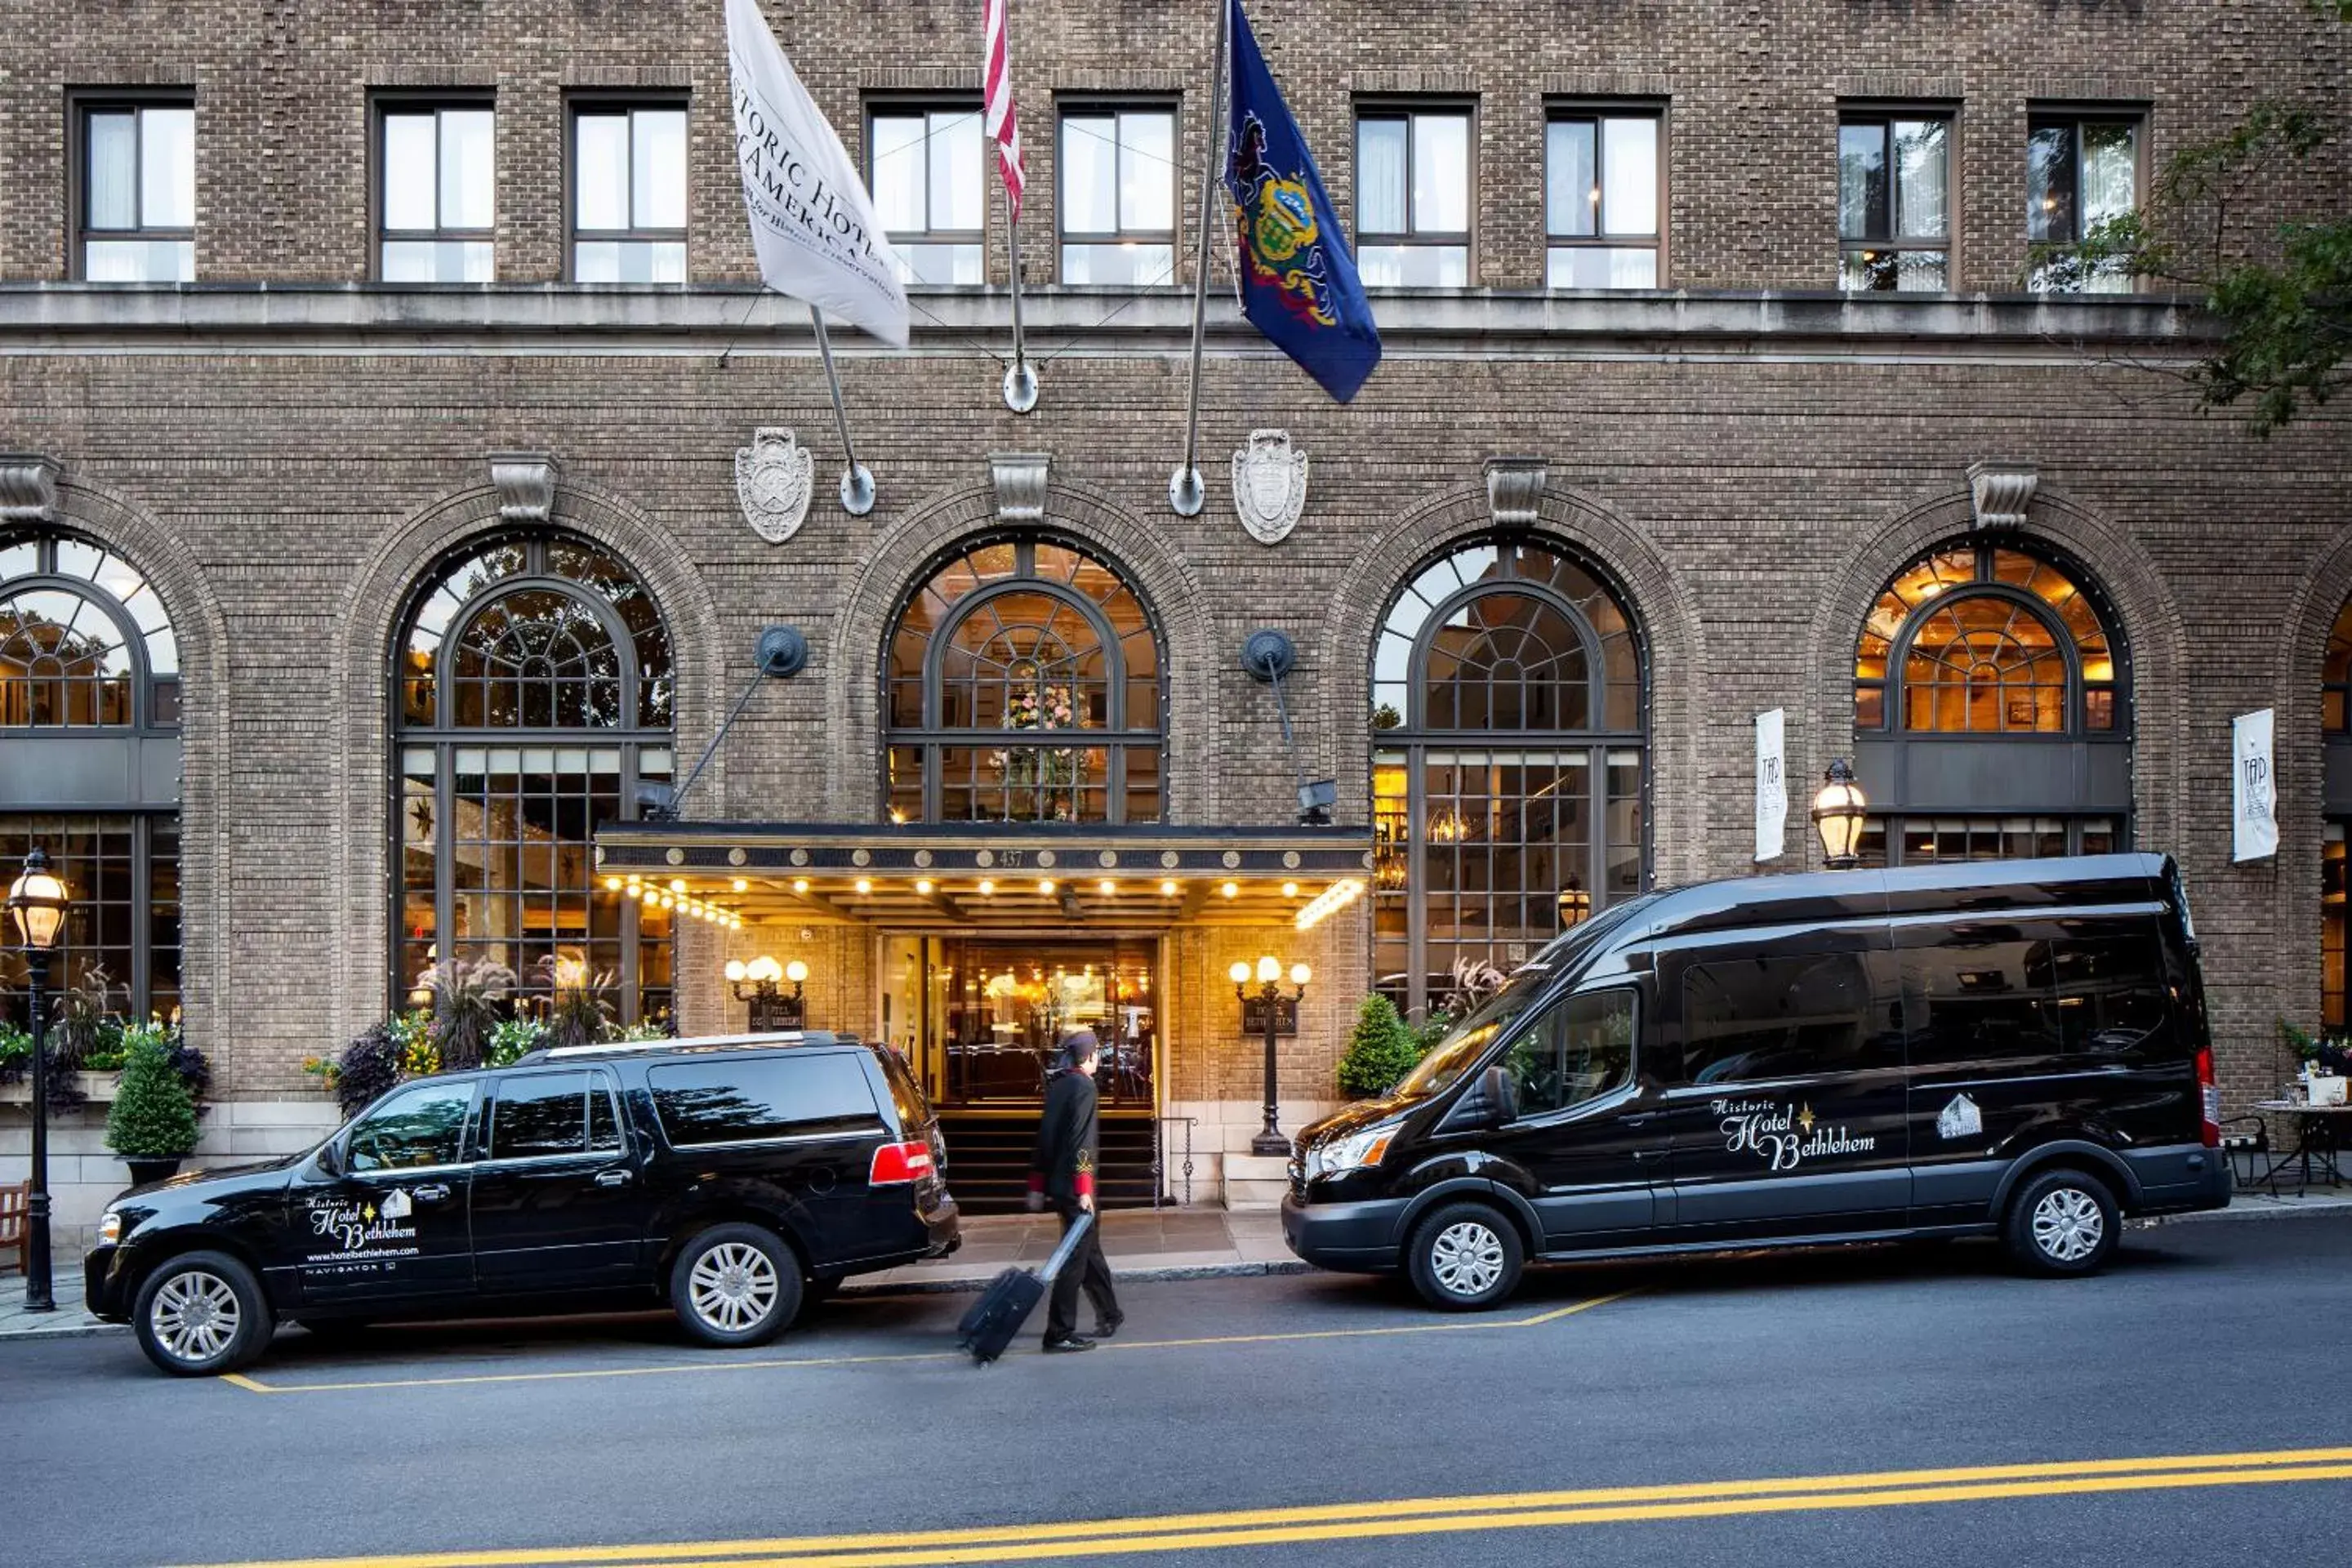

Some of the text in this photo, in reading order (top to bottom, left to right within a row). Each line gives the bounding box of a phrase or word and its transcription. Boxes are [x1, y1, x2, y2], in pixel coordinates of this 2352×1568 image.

[2243, 756, 2267, 786] TAP
[999, 850, 1022, 867] 437
[1710, 1099, 1775, 1115] Historic
[1720, 1103, 1793, 1152] Hotel
[1757, 1126, 1874, 1170] Bethlehem
[305, 1197, 349, 1208] Historic
[310, 1202, 361, 1235] Hotel
[334, 1219, 416, 1249] Bethlehem
[307, 1247, 419, 1262] www.hotelbethlehem.com
[305, 1265, 379, 1275] NAVIGATOR
